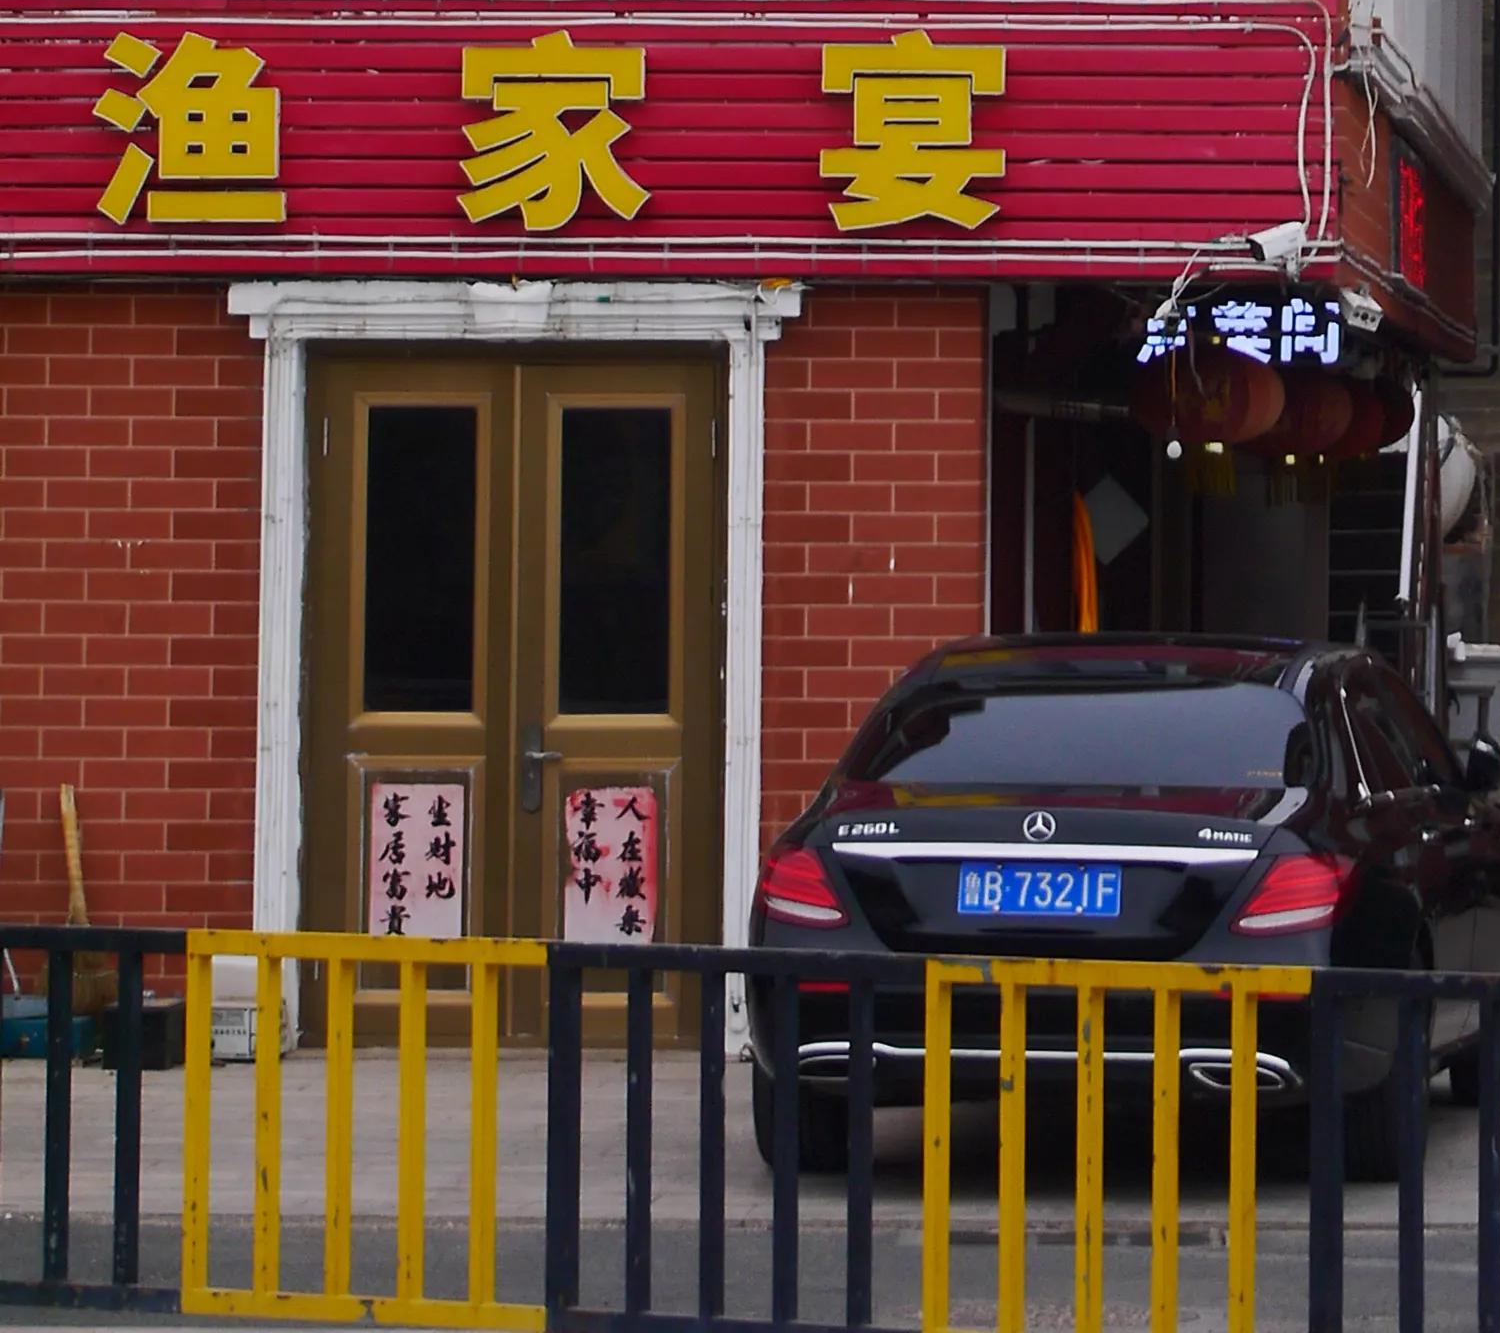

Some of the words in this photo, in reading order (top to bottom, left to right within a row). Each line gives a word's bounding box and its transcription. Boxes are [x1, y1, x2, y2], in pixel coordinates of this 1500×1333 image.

[93, 29, 1007, 232] 渔家宴
[572, 791, 605, 906] 幸福中
